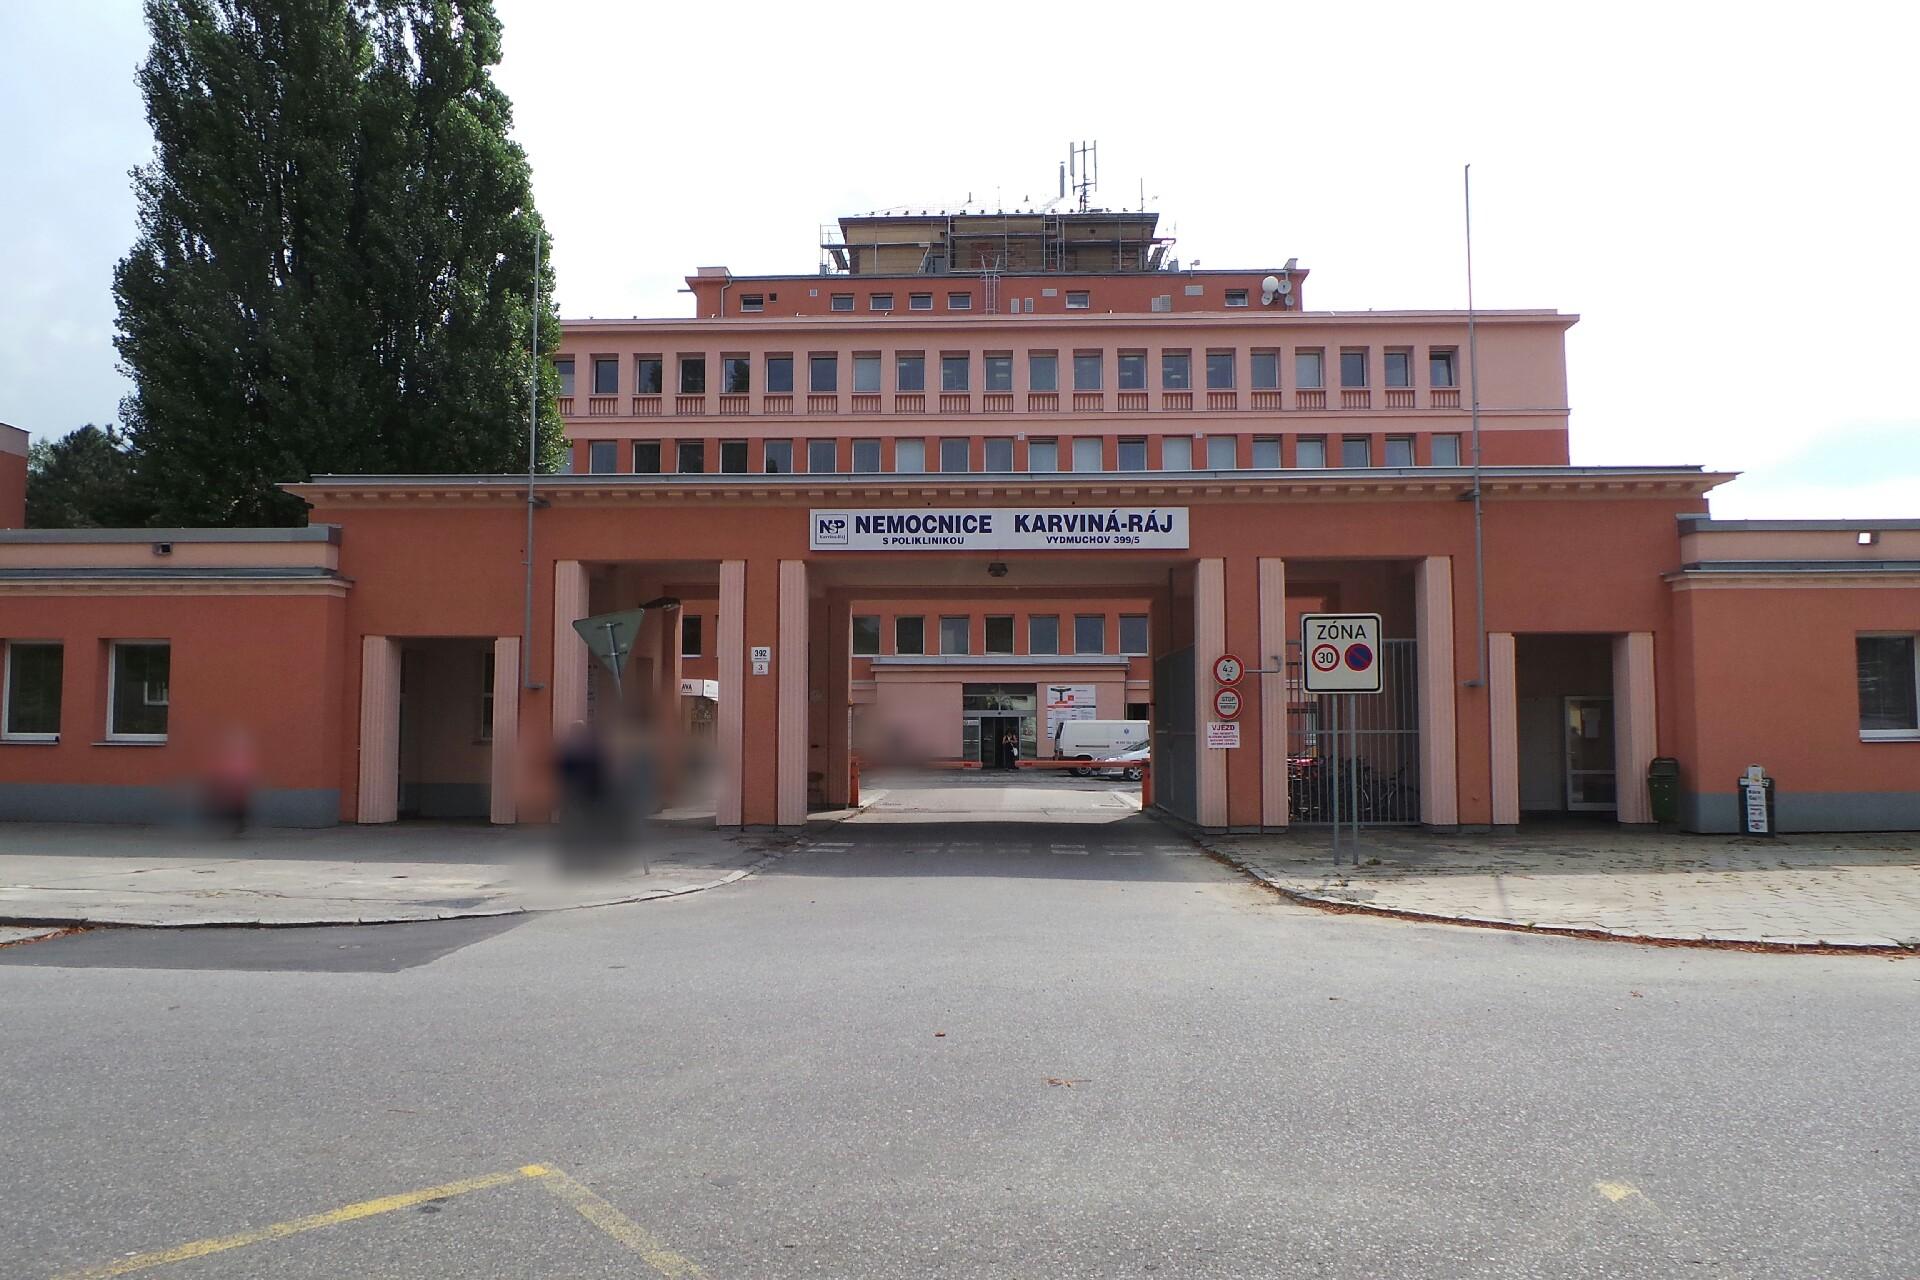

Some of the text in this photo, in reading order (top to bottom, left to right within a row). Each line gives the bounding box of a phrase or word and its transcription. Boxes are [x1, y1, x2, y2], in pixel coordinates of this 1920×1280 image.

[855, 509, 1173, 534] NEMOCNICE KARVINÁ-RÁJ
[882, 536, 965, 545] S POLIKLINIKOU
[1046, 535, 1140, 544] VYDMUCHOV 399/5
[1316, 620, 1367, 640] ZÓNA
[754, 649, 767, 657] 392
[1318, 651, 1334, 664] 30
